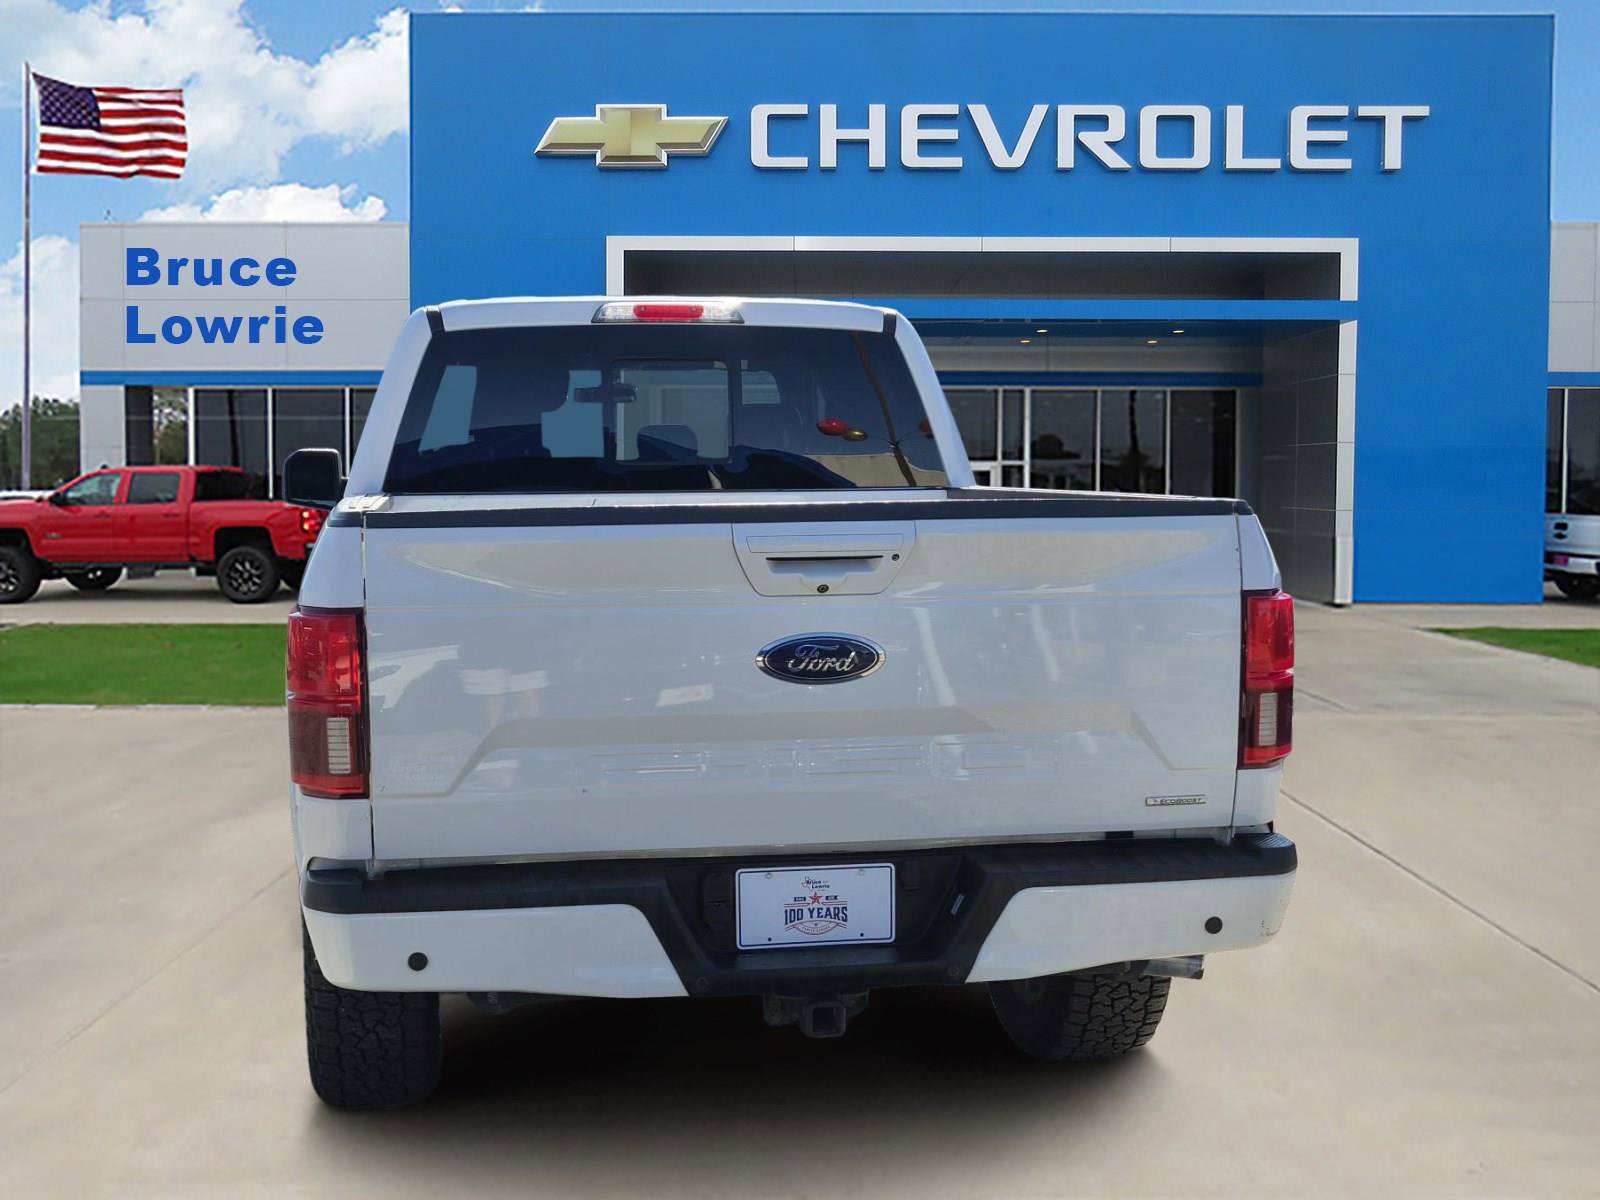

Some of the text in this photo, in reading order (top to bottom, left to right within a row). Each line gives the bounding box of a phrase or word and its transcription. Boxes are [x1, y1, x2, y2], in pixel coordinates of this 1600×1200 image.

[751, 104, 1430, 171] CHEVROLET
[126, 247, 298, 288] Bruce
[126, 305, 325, 345] Lowrie
[787, 643, 856, 673] Ford
[784, 906, 848, 926] 100 YEARS
